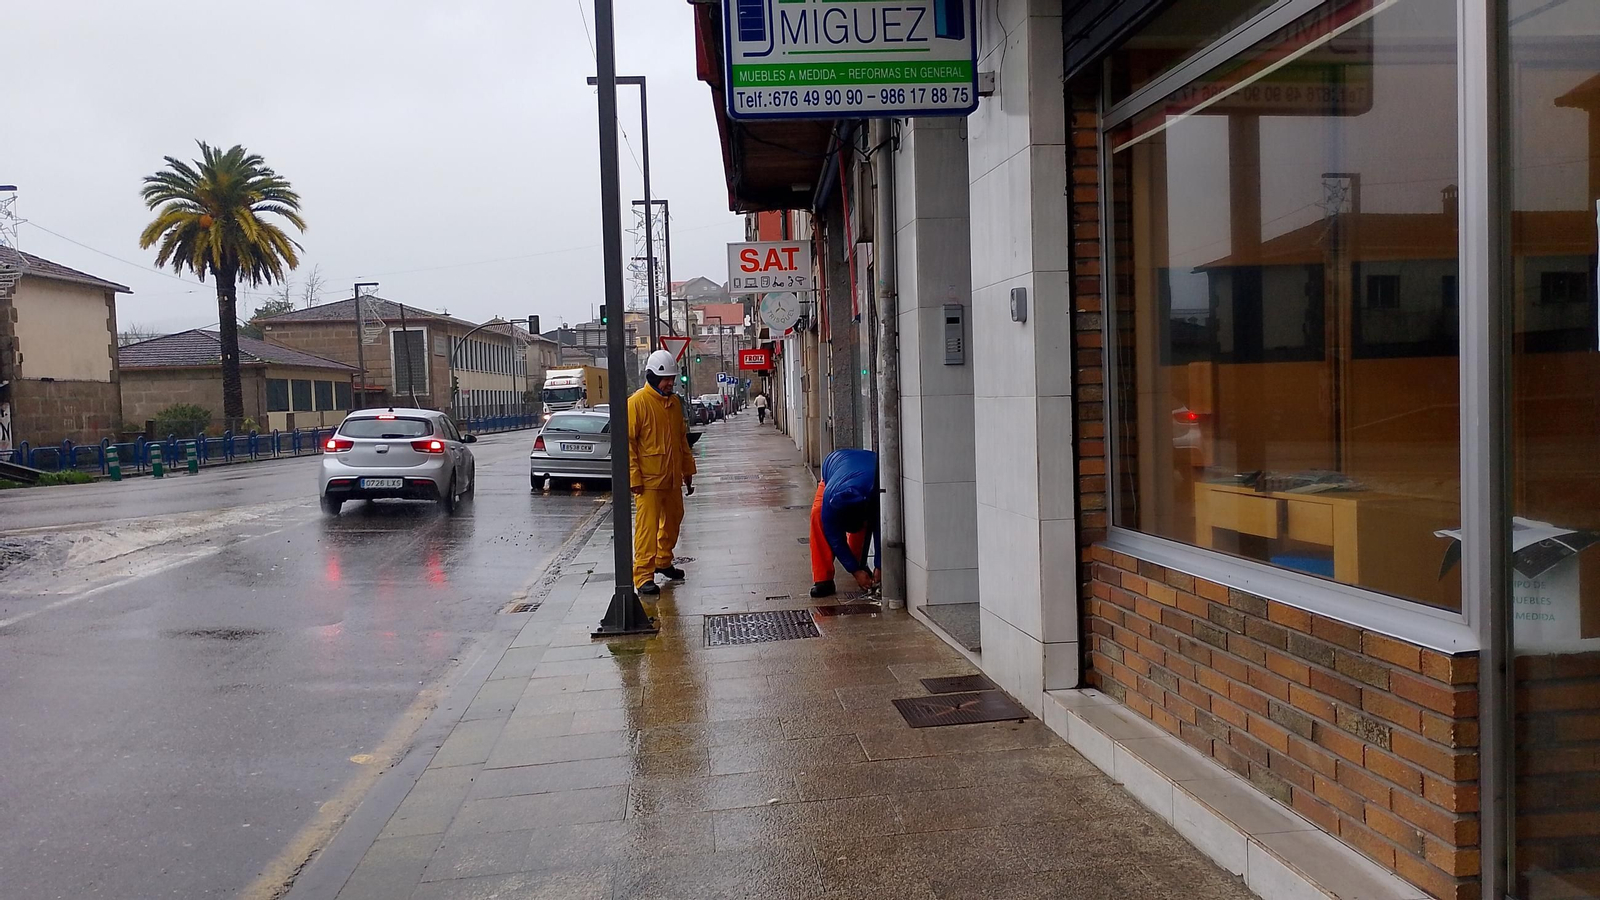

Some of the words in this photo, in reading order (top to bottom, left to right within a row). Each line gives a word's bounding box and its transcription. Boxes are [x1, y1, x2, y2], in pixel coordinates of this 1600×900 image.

[780, 7, 928, 45] MIGUEZ
[739, 70, 786, 82] MUEBLES
[788, 69, 797, 80] A
[798, 69, 837, 80] MEDIDA
[848, 67, 902, 80] REFORMAS
[904, 67, 917, 78] EN
[920, 67, 965, 78] GENERAL
[803, 90, 820, 106] 49
[824, 89, 842, 106] 90
[846, 89, 863, 105] 90
[880, 88, 906, 105] 986
[910, 87, 926, 104] 17
[931, 87, 948, 104] 88
[952, 87, 969, 103] 75
[740, 247, 800, 273] S.A.T.
[767, 308, 795, 324] TRISQUEL
[1513, 596, 1551, 605] UEBLES
[1515, 612, 1555, 621] MEDIDA
